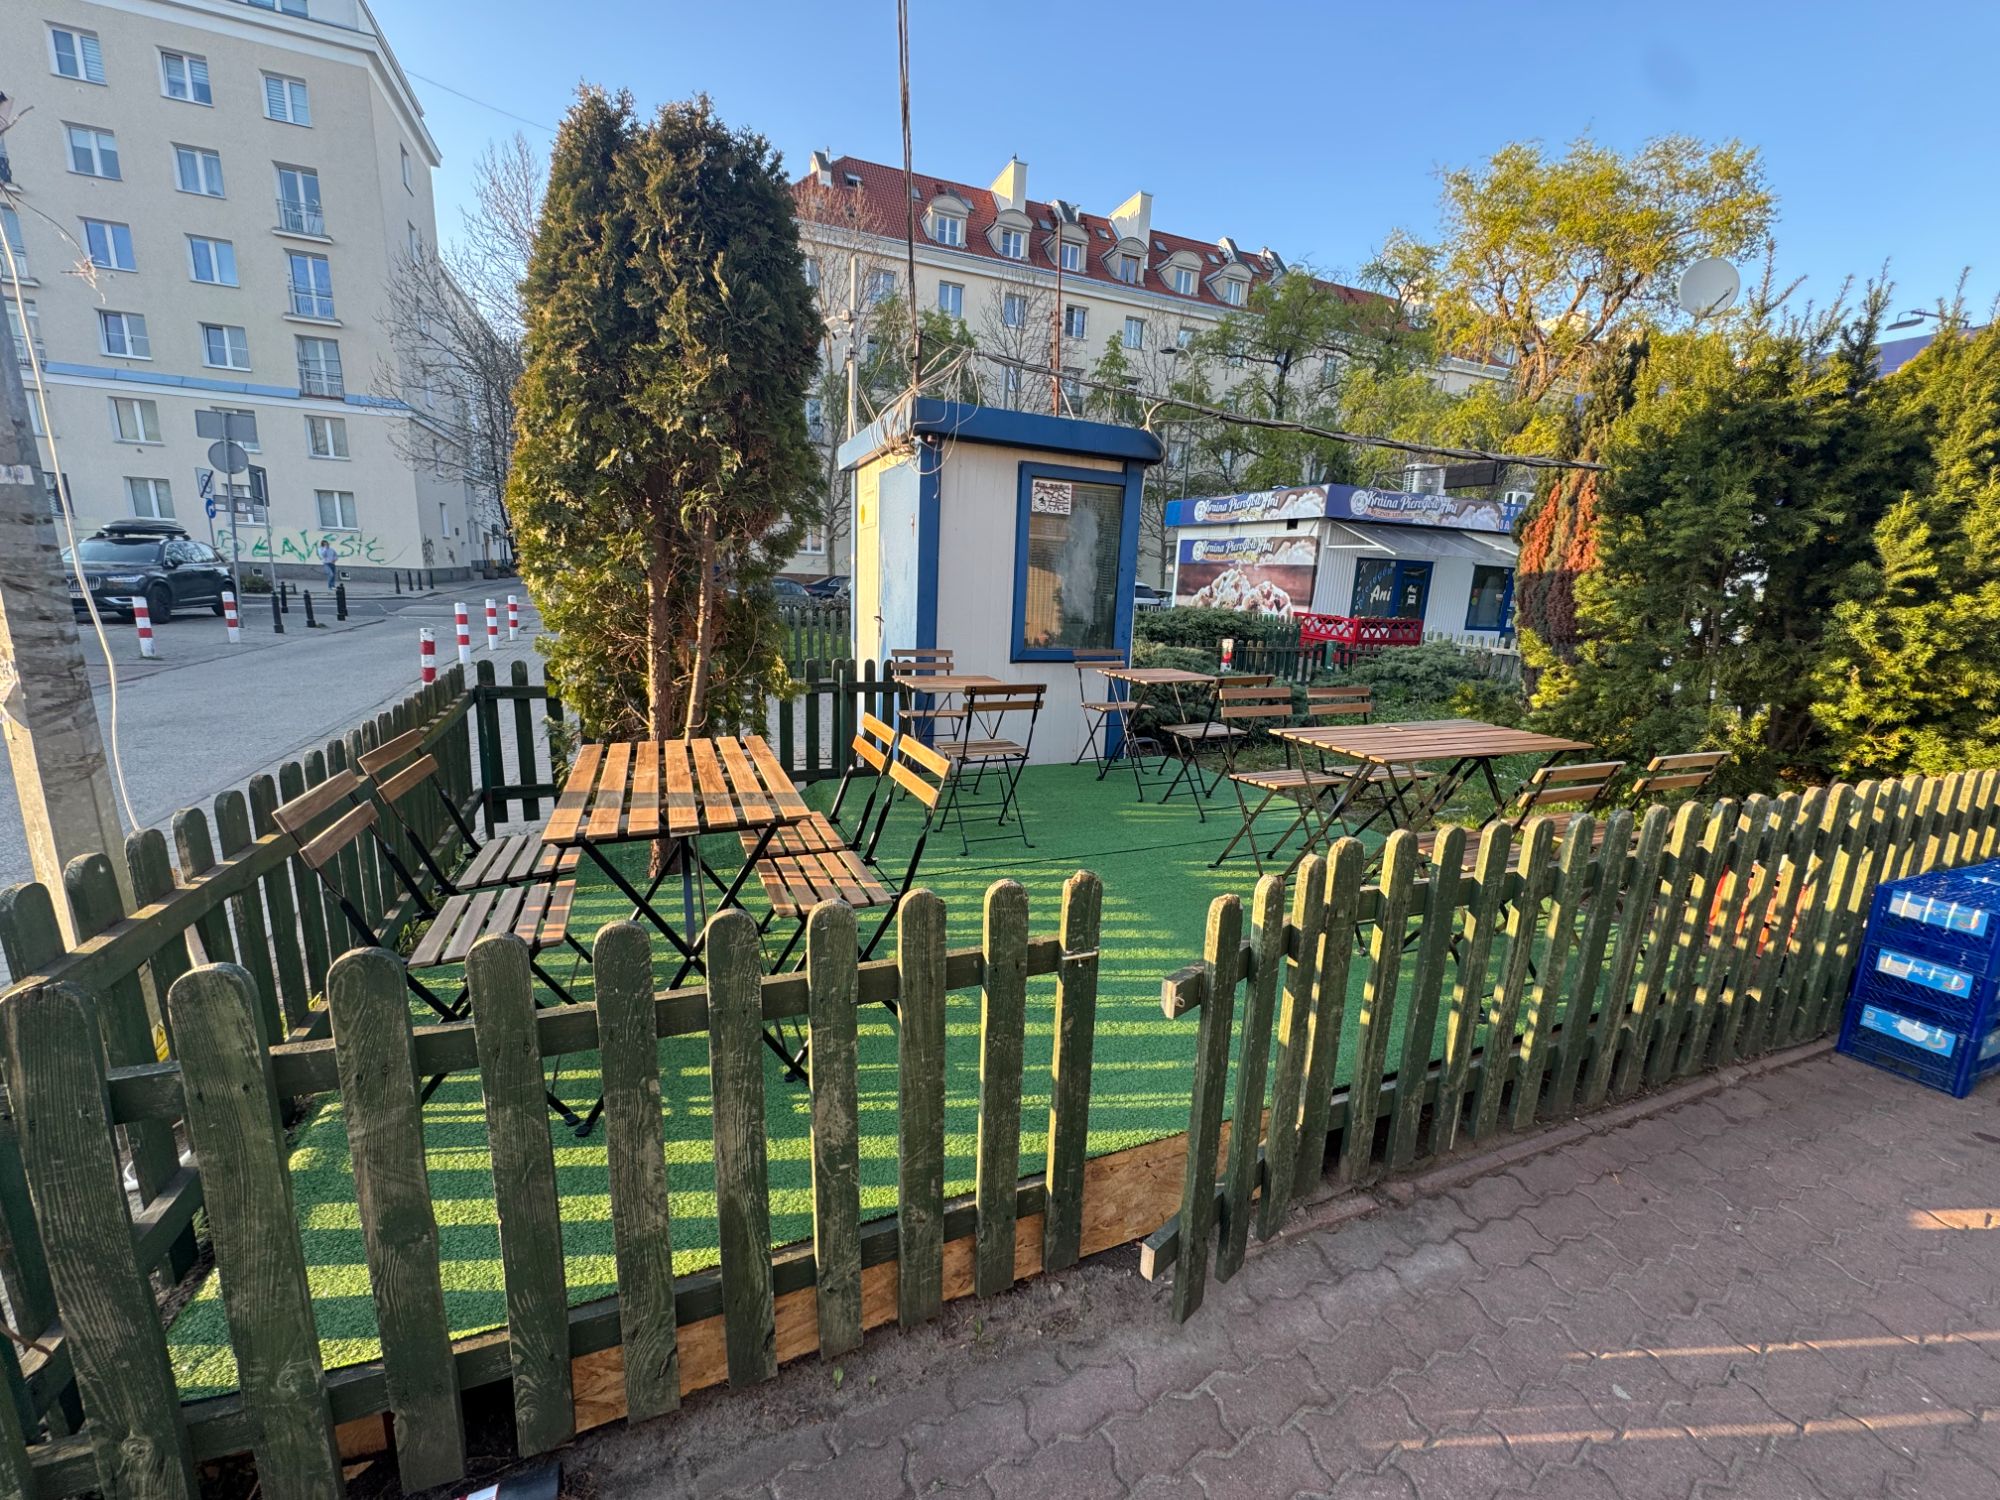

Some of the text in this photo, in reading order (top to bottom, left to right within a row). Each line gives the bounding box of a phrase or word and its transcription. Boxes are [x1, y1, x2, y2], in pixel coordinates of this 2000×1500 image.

[1367, 491, 1399, 509] Kraina
[1440, 502, 1458, 514] Ani
[1370, 584, 1392, 604] Ani
